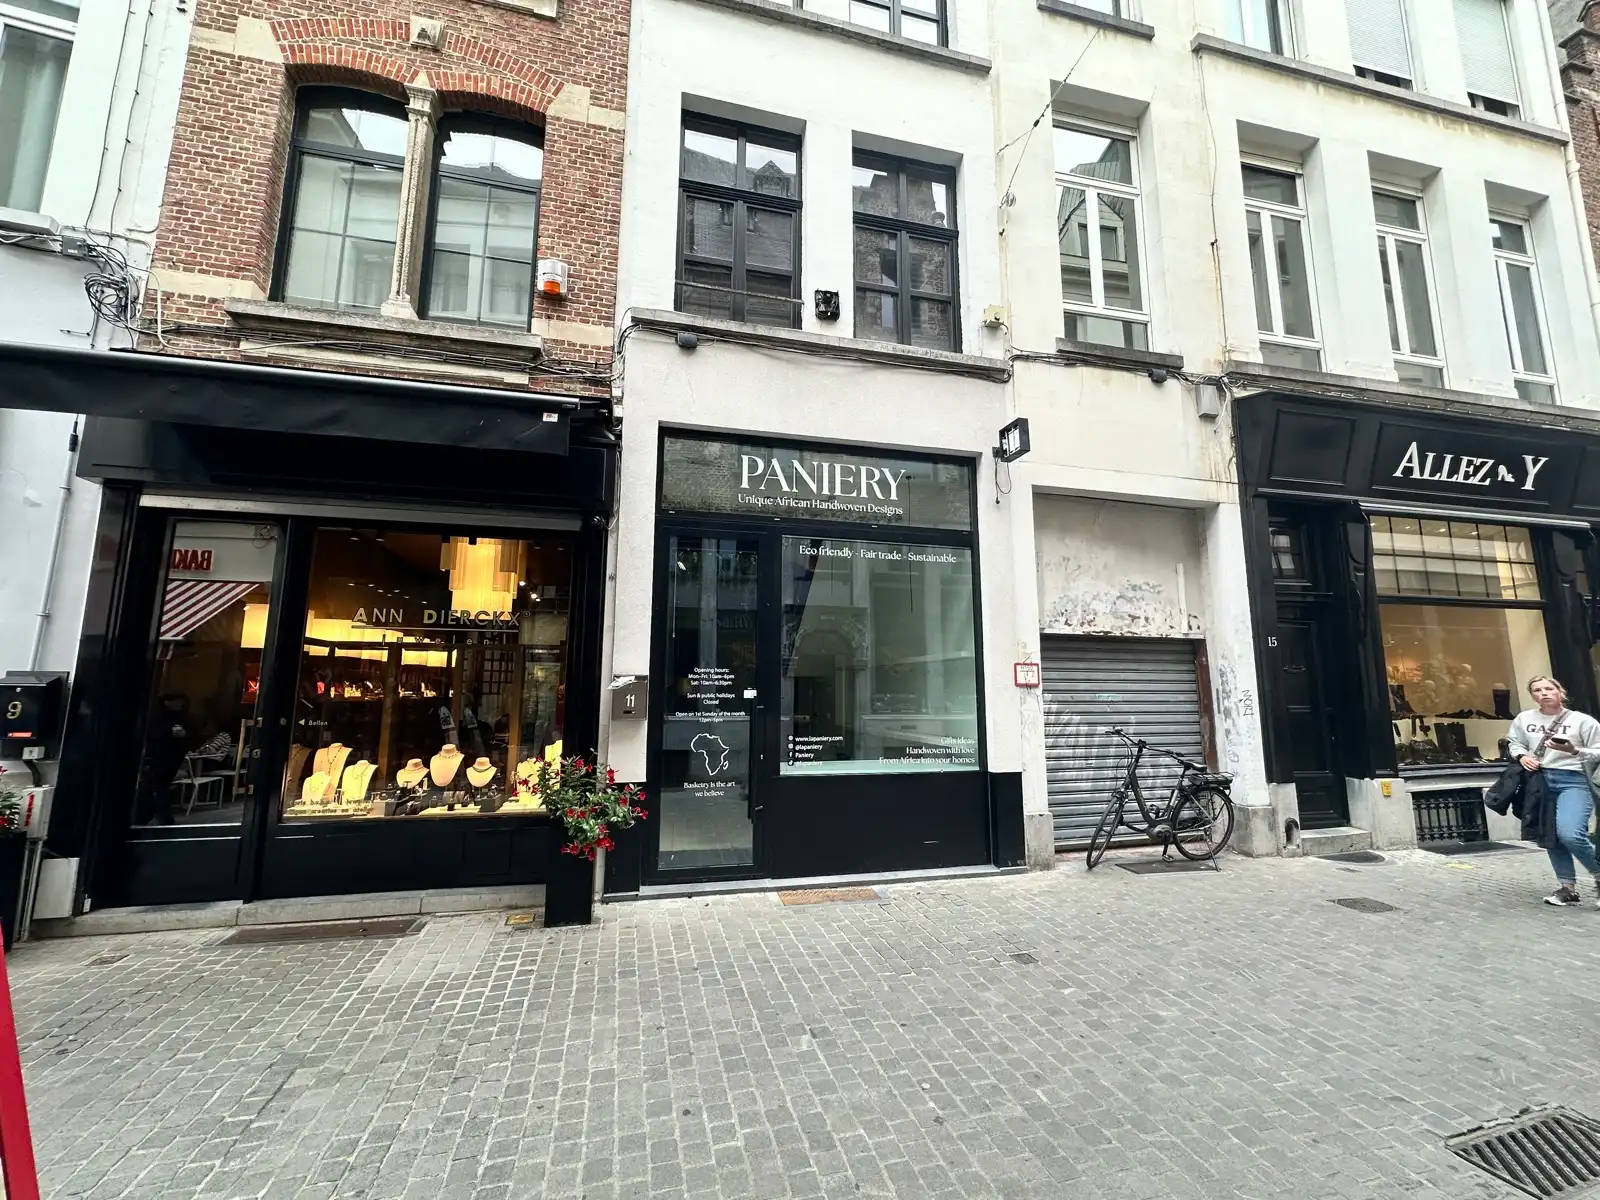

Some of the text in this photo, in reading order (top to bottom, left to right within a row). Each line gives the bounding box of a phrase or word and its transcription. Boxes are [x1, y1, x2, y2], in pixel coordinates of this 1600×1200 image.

[1392, 441, 1549, 491] ALLEZ Y
[739, 454, 907, 501] PANIERY
[738, 493, 904, 516] Unique African Handwoven Designs
[799, 545, 817, 555] Eco
[818, 545, 854, 559] friendly
[860, 549, 877, 559] Fair
[878, 550, 902, 560] trade
[907, 552, 957, 563] Sustainable
[353, 607, 404, 623] ANN
[1267, 636, 1278, 647] 15
[625, 694, 635, 708] 11
[6, 701, 22, 720] 9
[906, 746, 945, 754] Handwoven
[946, 746, 960, 754] with
[879, 755, 975, 765] From Africa into your homes
[683, 781, 709, 789] Basketry
[703, 789, 725, 797] believe
